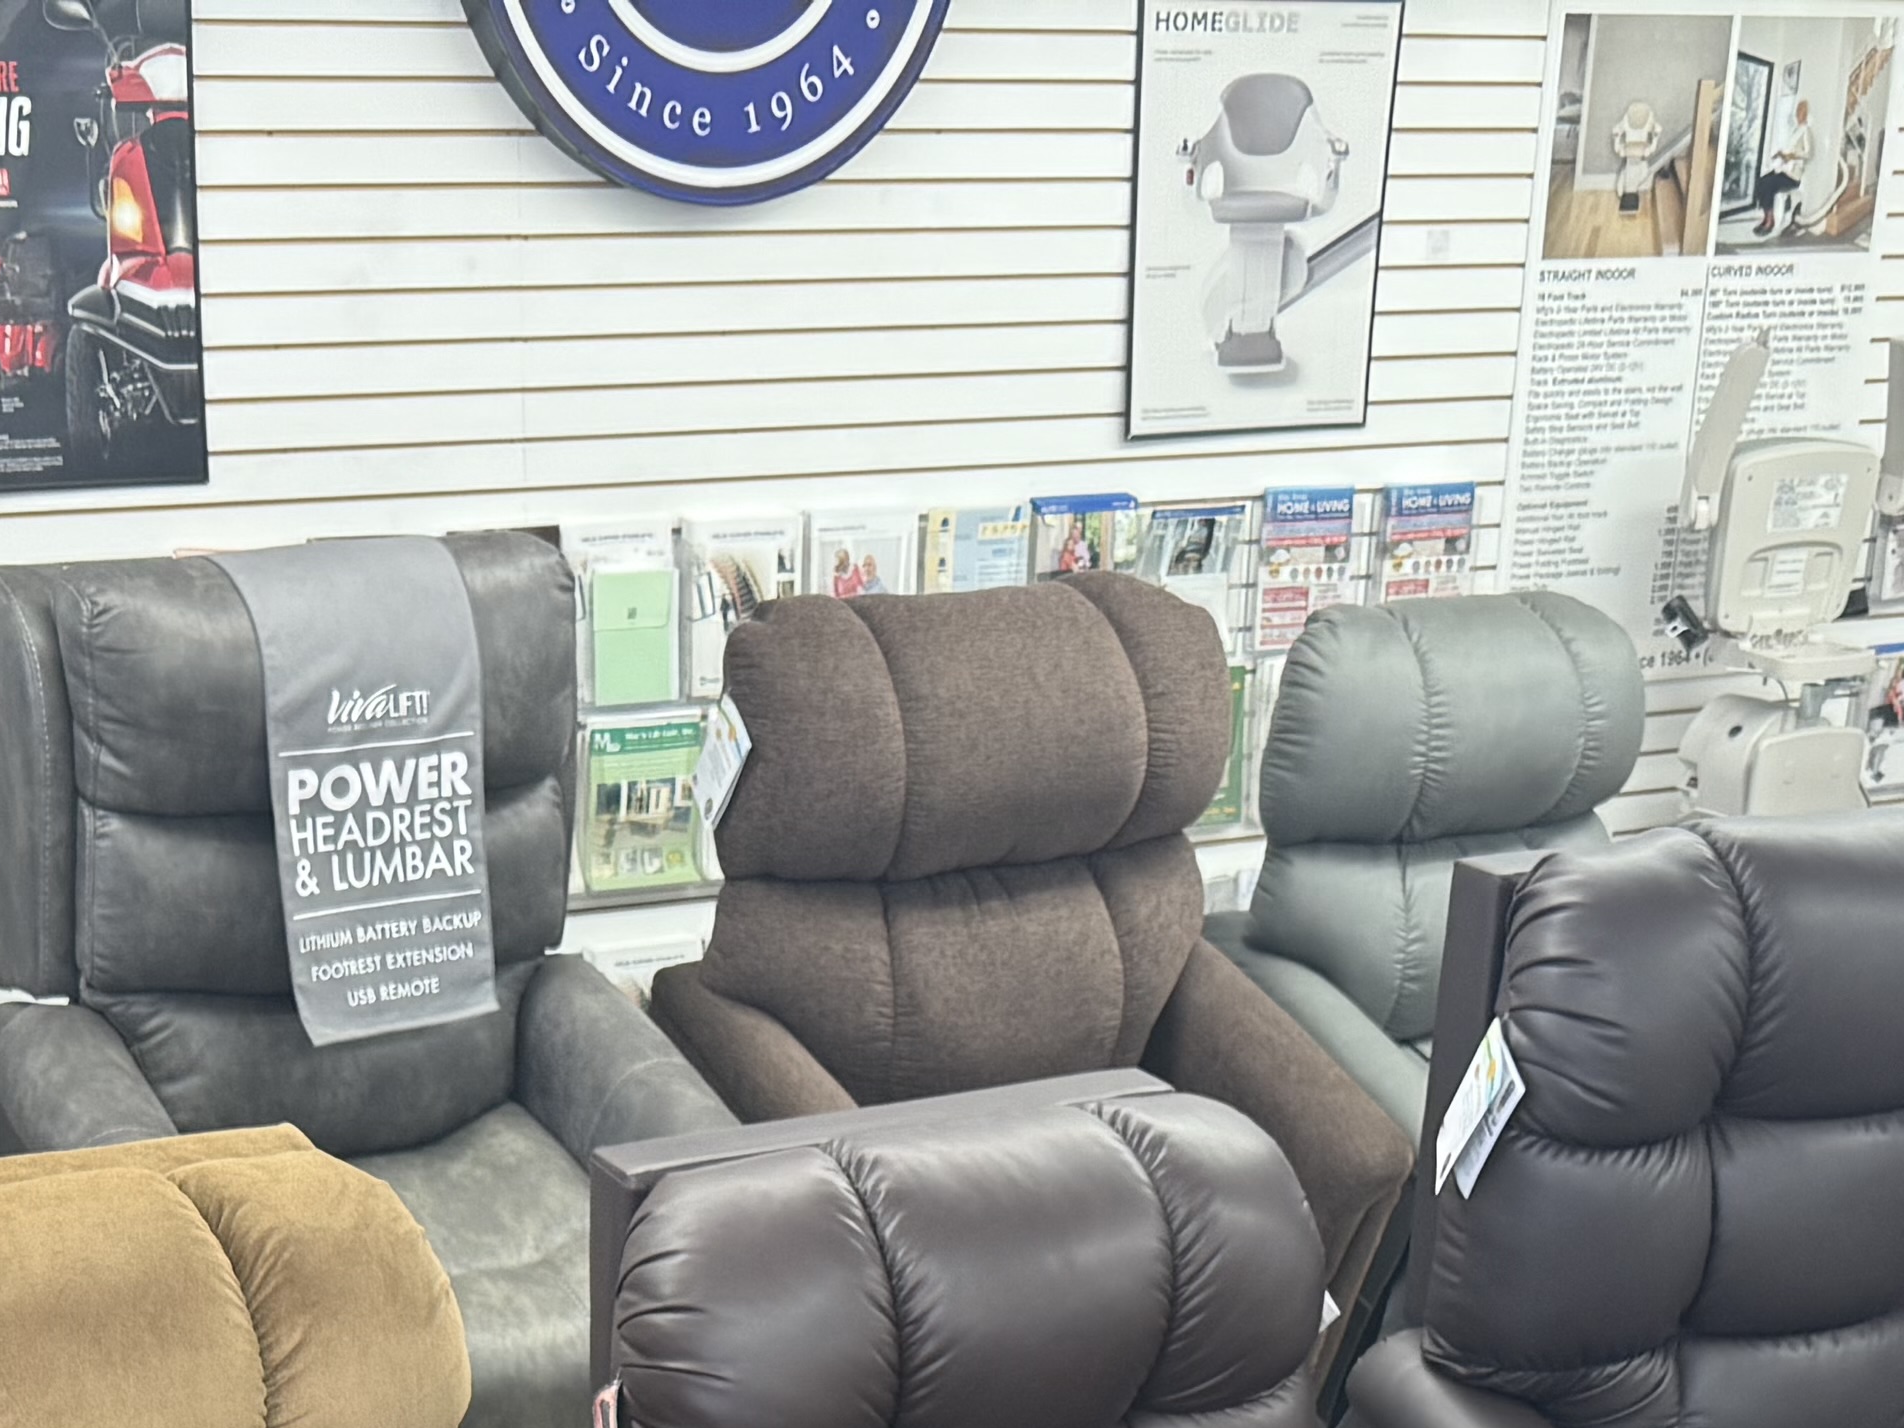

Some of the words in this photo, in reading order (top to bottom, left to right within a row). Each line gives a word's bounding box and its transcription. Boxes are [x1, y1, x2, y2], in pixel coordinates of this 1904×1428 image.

[1155, 10, 1300, 34] HOMEGLIDE
[577, 33, 712, 137] Since
[744, 44, 857, 135] 1964
[1539, 268, 1593, 284] STRAIGHT
[287, 750, 473, 816] POWER
[290, 798, 473, 857] HEADREST
[295, 858, 320, 898] &
[331, 838, 476, 892] LUMBAR
[298, 928, 354, 954] LITHIUM
[356, 919, 419, 944] BATTERY
[422, 910, 483, 935] BACKUP
[311, 955, 383, 983] FOOTREST
[386, 942, 475, 970] EXTENSION
[346, 986, 378, 1008] USB
[380, 976, 441, 1002] REMOTE
